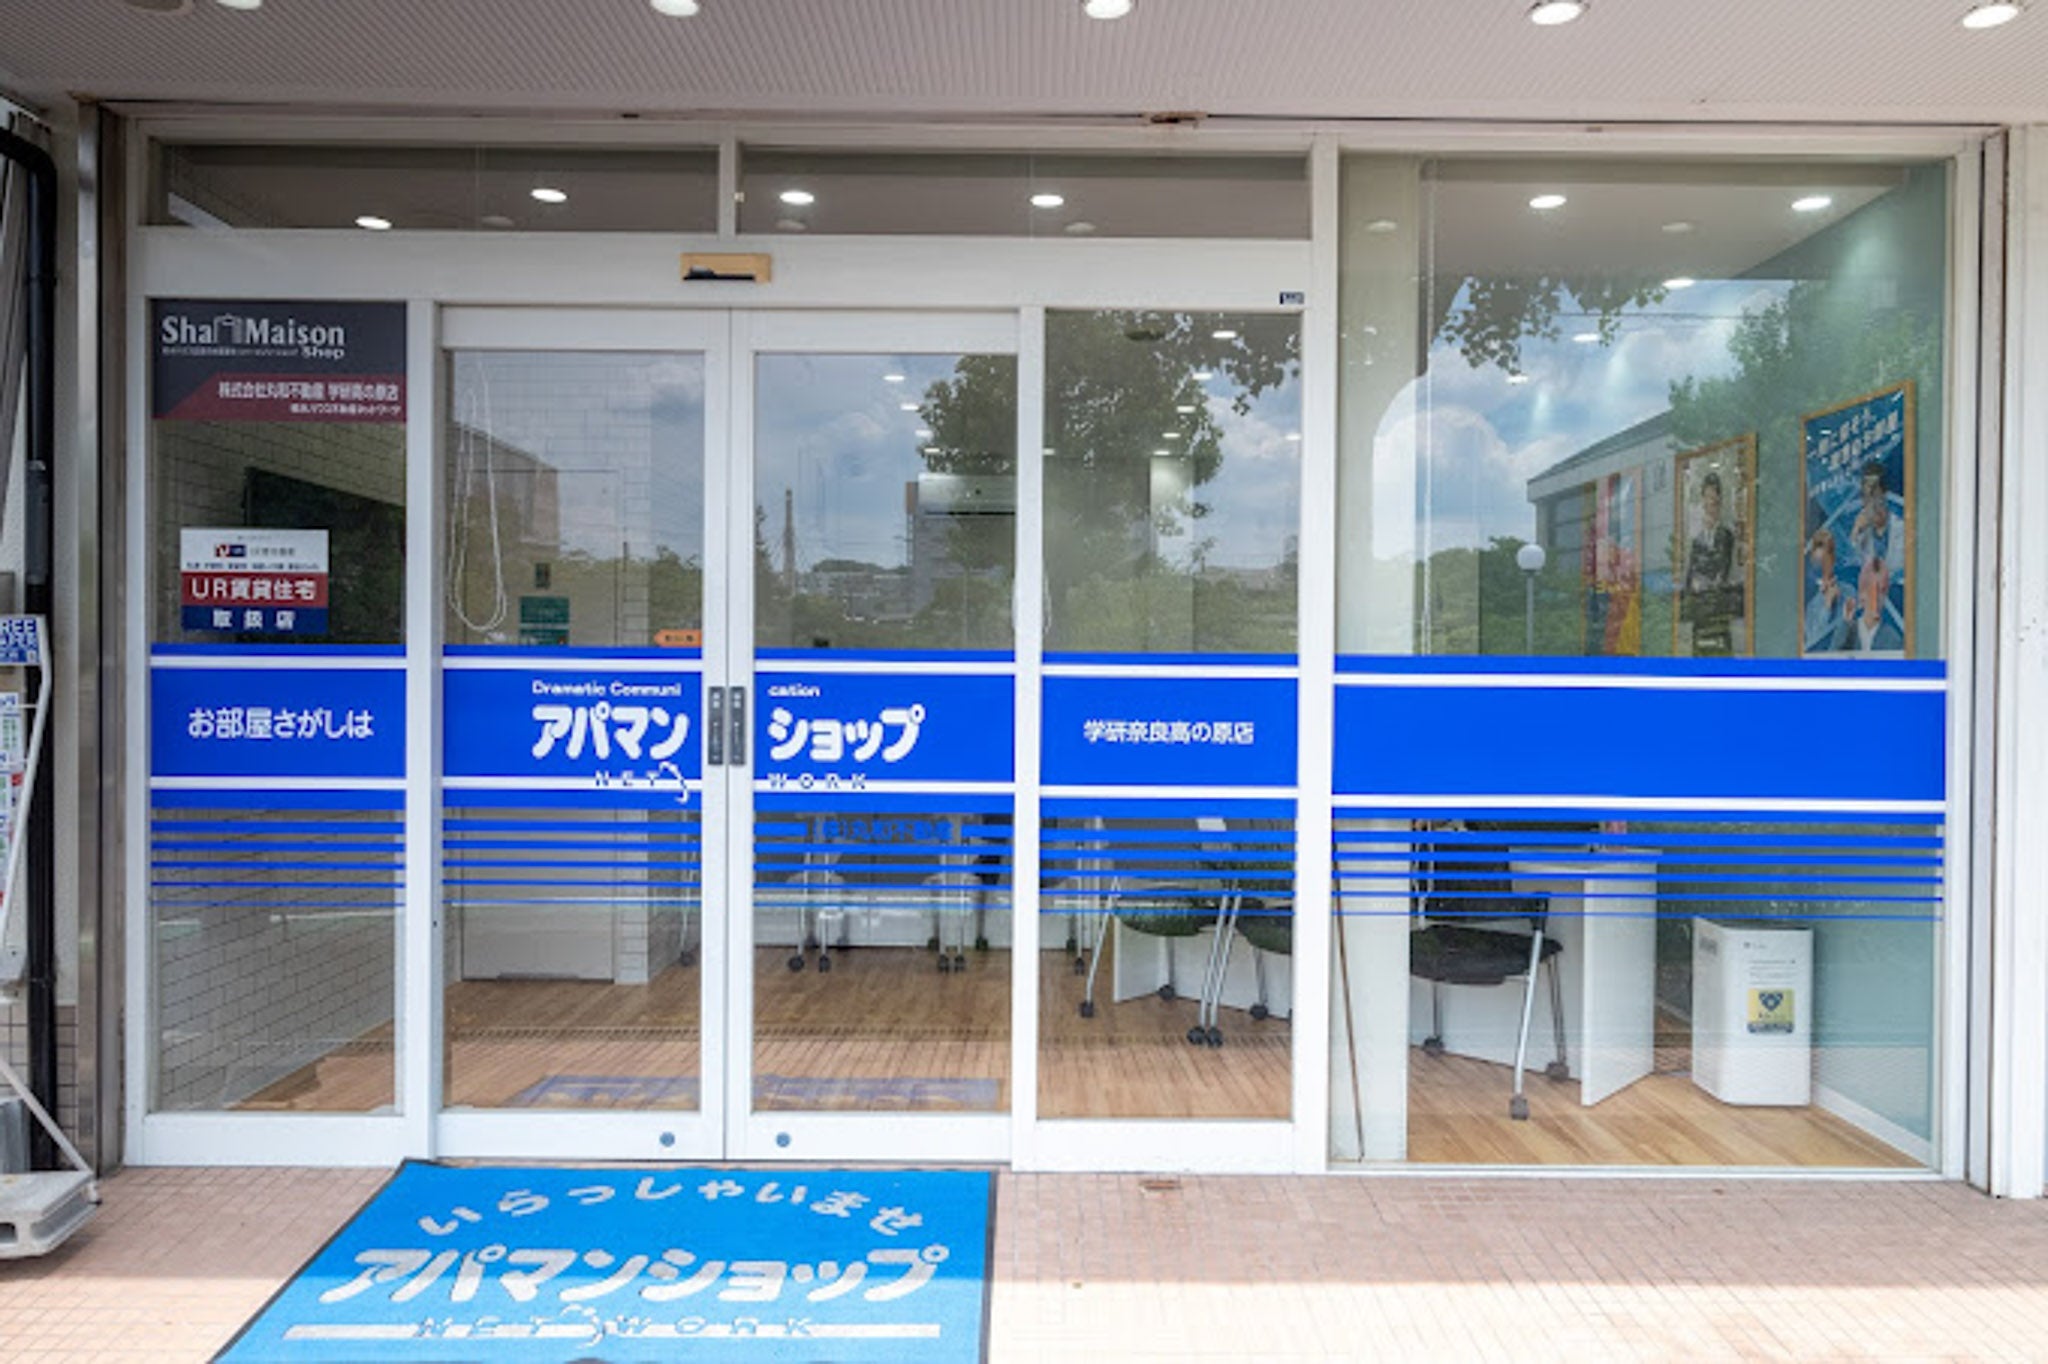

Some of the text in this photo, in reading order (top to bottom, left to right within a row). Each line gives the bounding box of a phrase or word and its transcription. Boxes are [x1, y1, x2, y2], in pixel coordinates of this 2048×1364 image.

[245, 317, 345, 346] Maison
[302, 346, 345, 360] Shop
[191, 577, 316, 601] UR賃貸住宅
[532, 679, 821, 697] Dramatic Communi cation
[188, 706, 375, 740] お部屋さがしは
[531, 700, 926, 763] アパマン ショップ
[1083, 718, 1255, 745] 学研奈良高の原店
[418, 1176, 923, 1237] いらっしゃいませ
[318, 1244, 950, 1303] アパマンショップ
